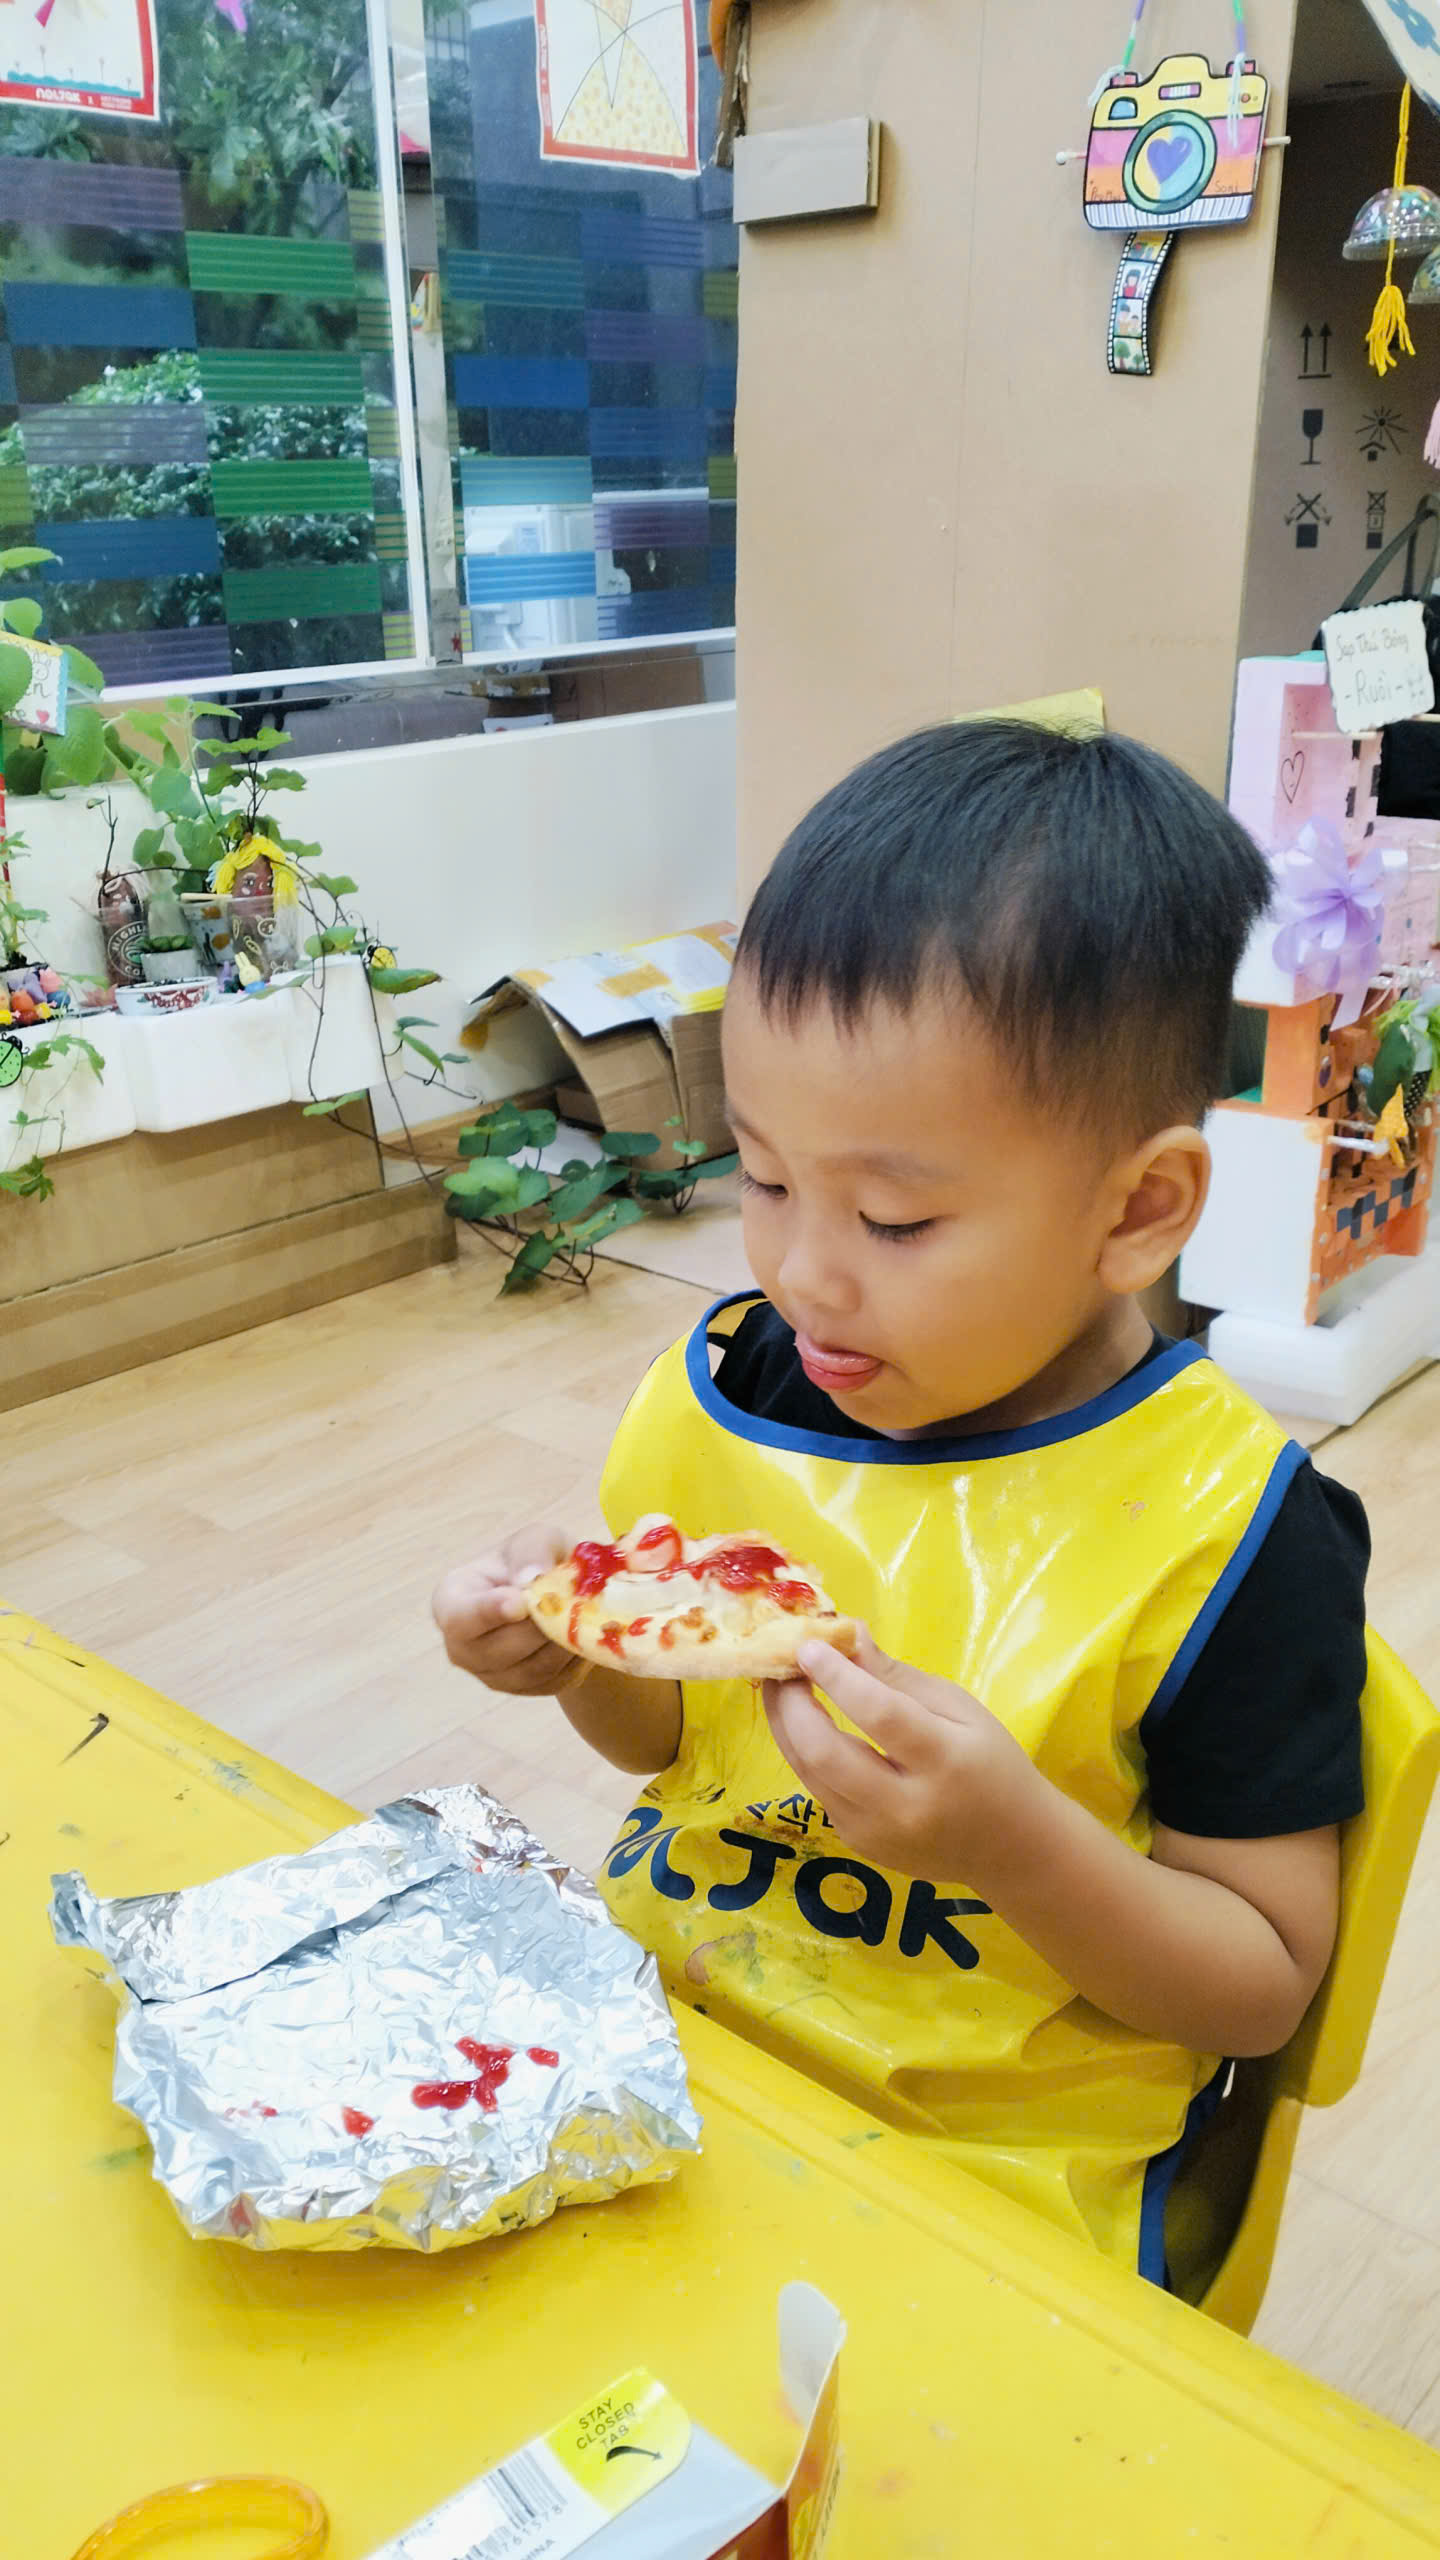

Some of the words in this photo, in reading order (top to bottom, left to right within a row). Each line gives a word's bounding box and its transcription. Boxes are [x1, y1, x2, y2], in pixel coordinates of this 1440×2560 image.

[111, 923, 146, 952] HIGHL
[576, 2402, 636, 2450] CLOSED
[578, 2397, 613, 2430] STAY
[600, 2424, 629, 2449] TAB
